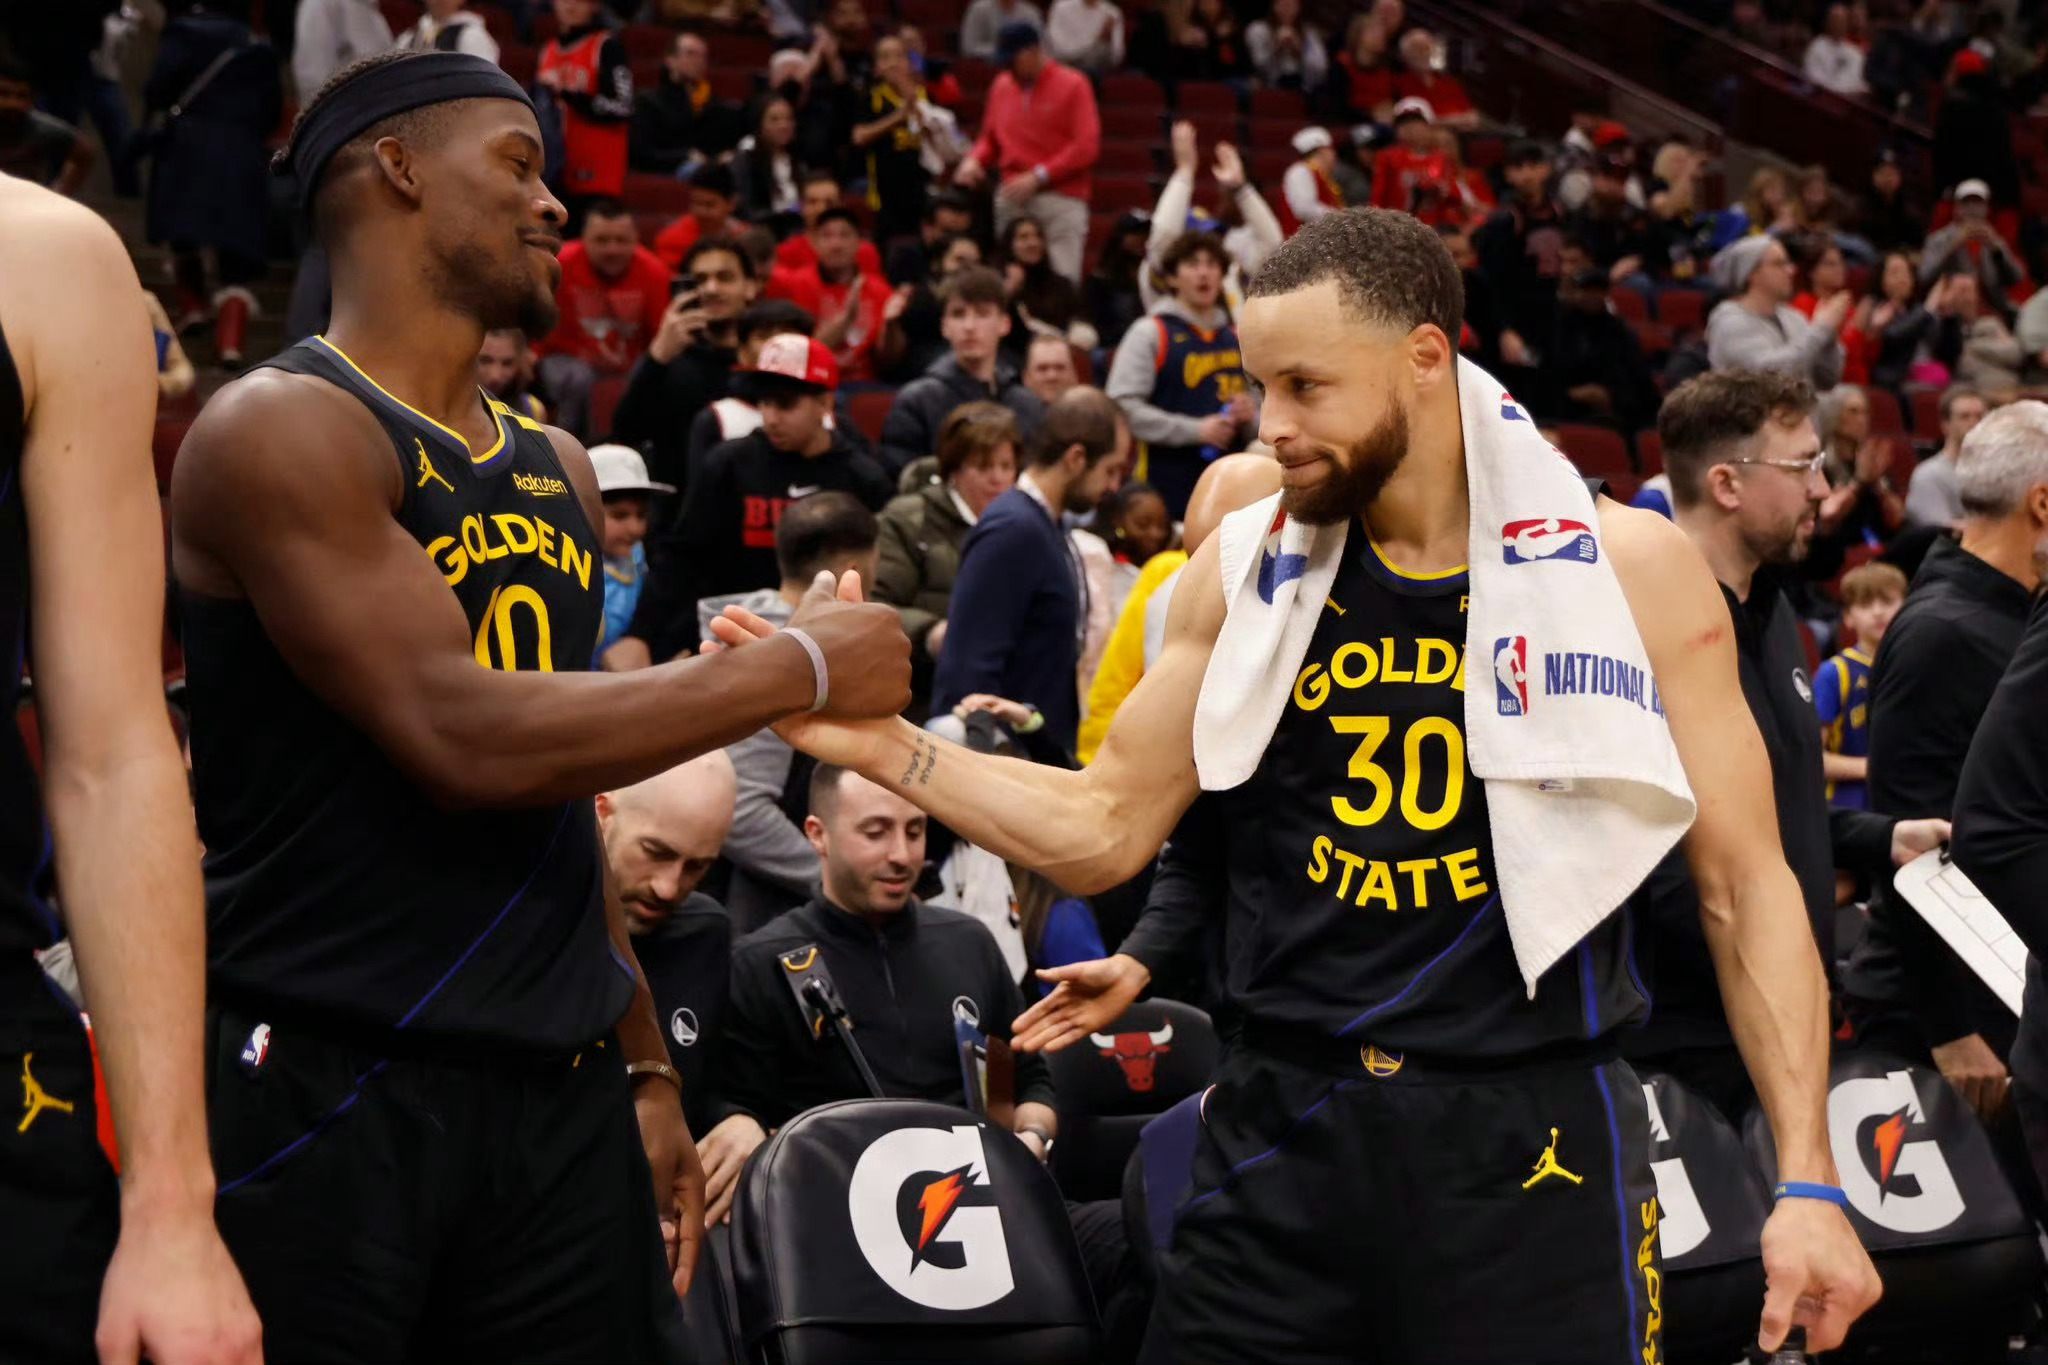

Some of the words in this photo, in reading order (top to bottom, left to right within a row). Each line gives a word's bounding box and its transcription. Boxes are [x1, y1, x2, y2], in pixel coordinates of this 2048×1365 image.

[512, 473, 568, 495] Rakuten
[426, 513, 592, 591] GOLDEN
[1580, 538, 1594, 560] NBA
[475, 584, 553, 672] 10
[1501, 700, 1518, 713] NBA
[1545, 653, 1647, 711] NATIONAL
[1329, 716, 1464, 831] 30
[1307, 835, 1488, 911] STATE
[849, 1125, 1015, 1311] G
